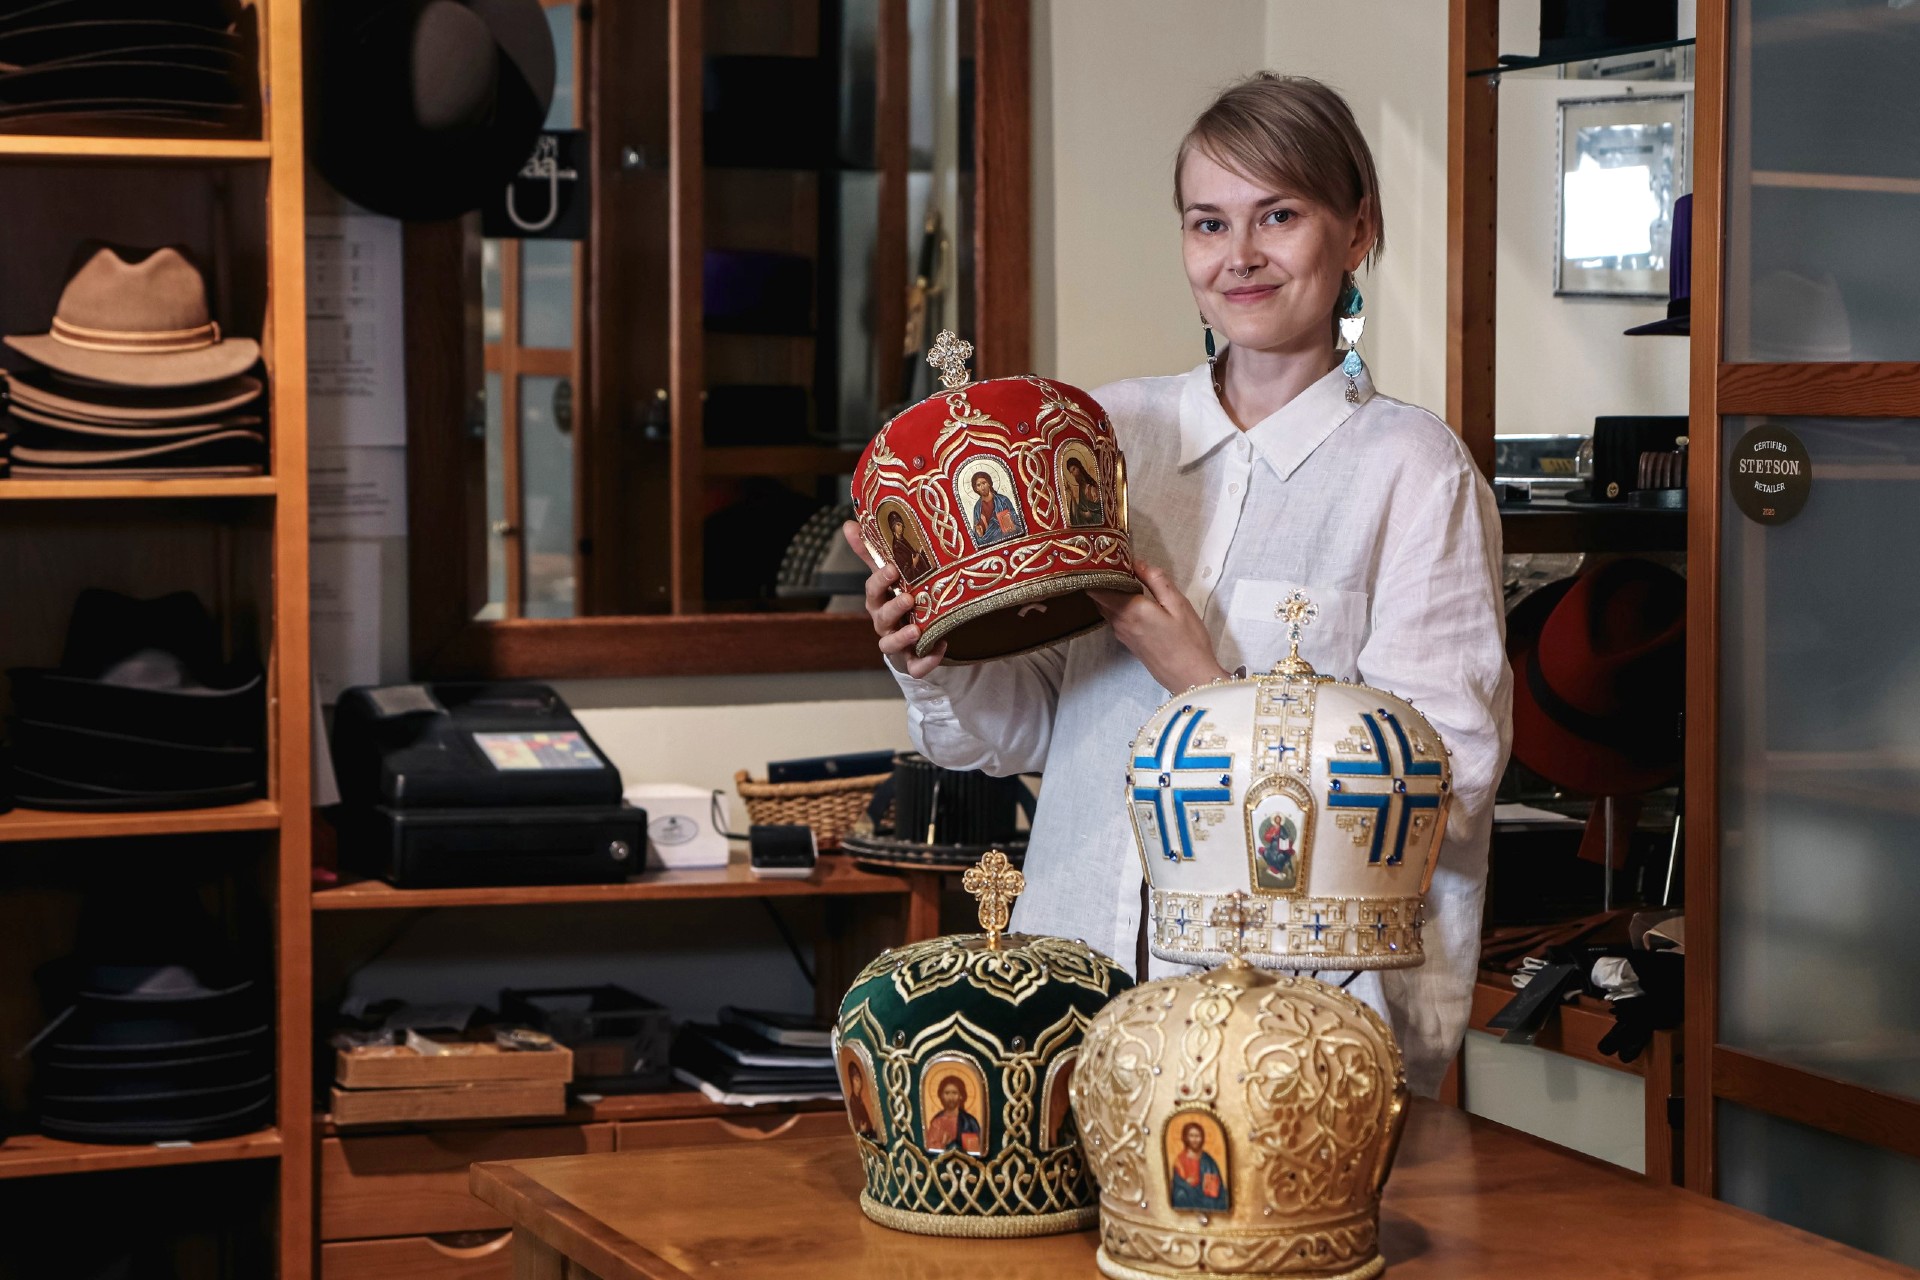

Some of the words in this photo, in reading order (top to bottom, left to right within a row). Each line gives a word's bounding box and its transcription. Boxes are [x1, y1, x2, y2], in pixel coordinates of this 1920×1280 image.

[1754, 441, 1787, 453] CERTIFIED
[1739, 459, 1800, 475] STETSON
[1754, 481, 1786, 493] RETAILER
